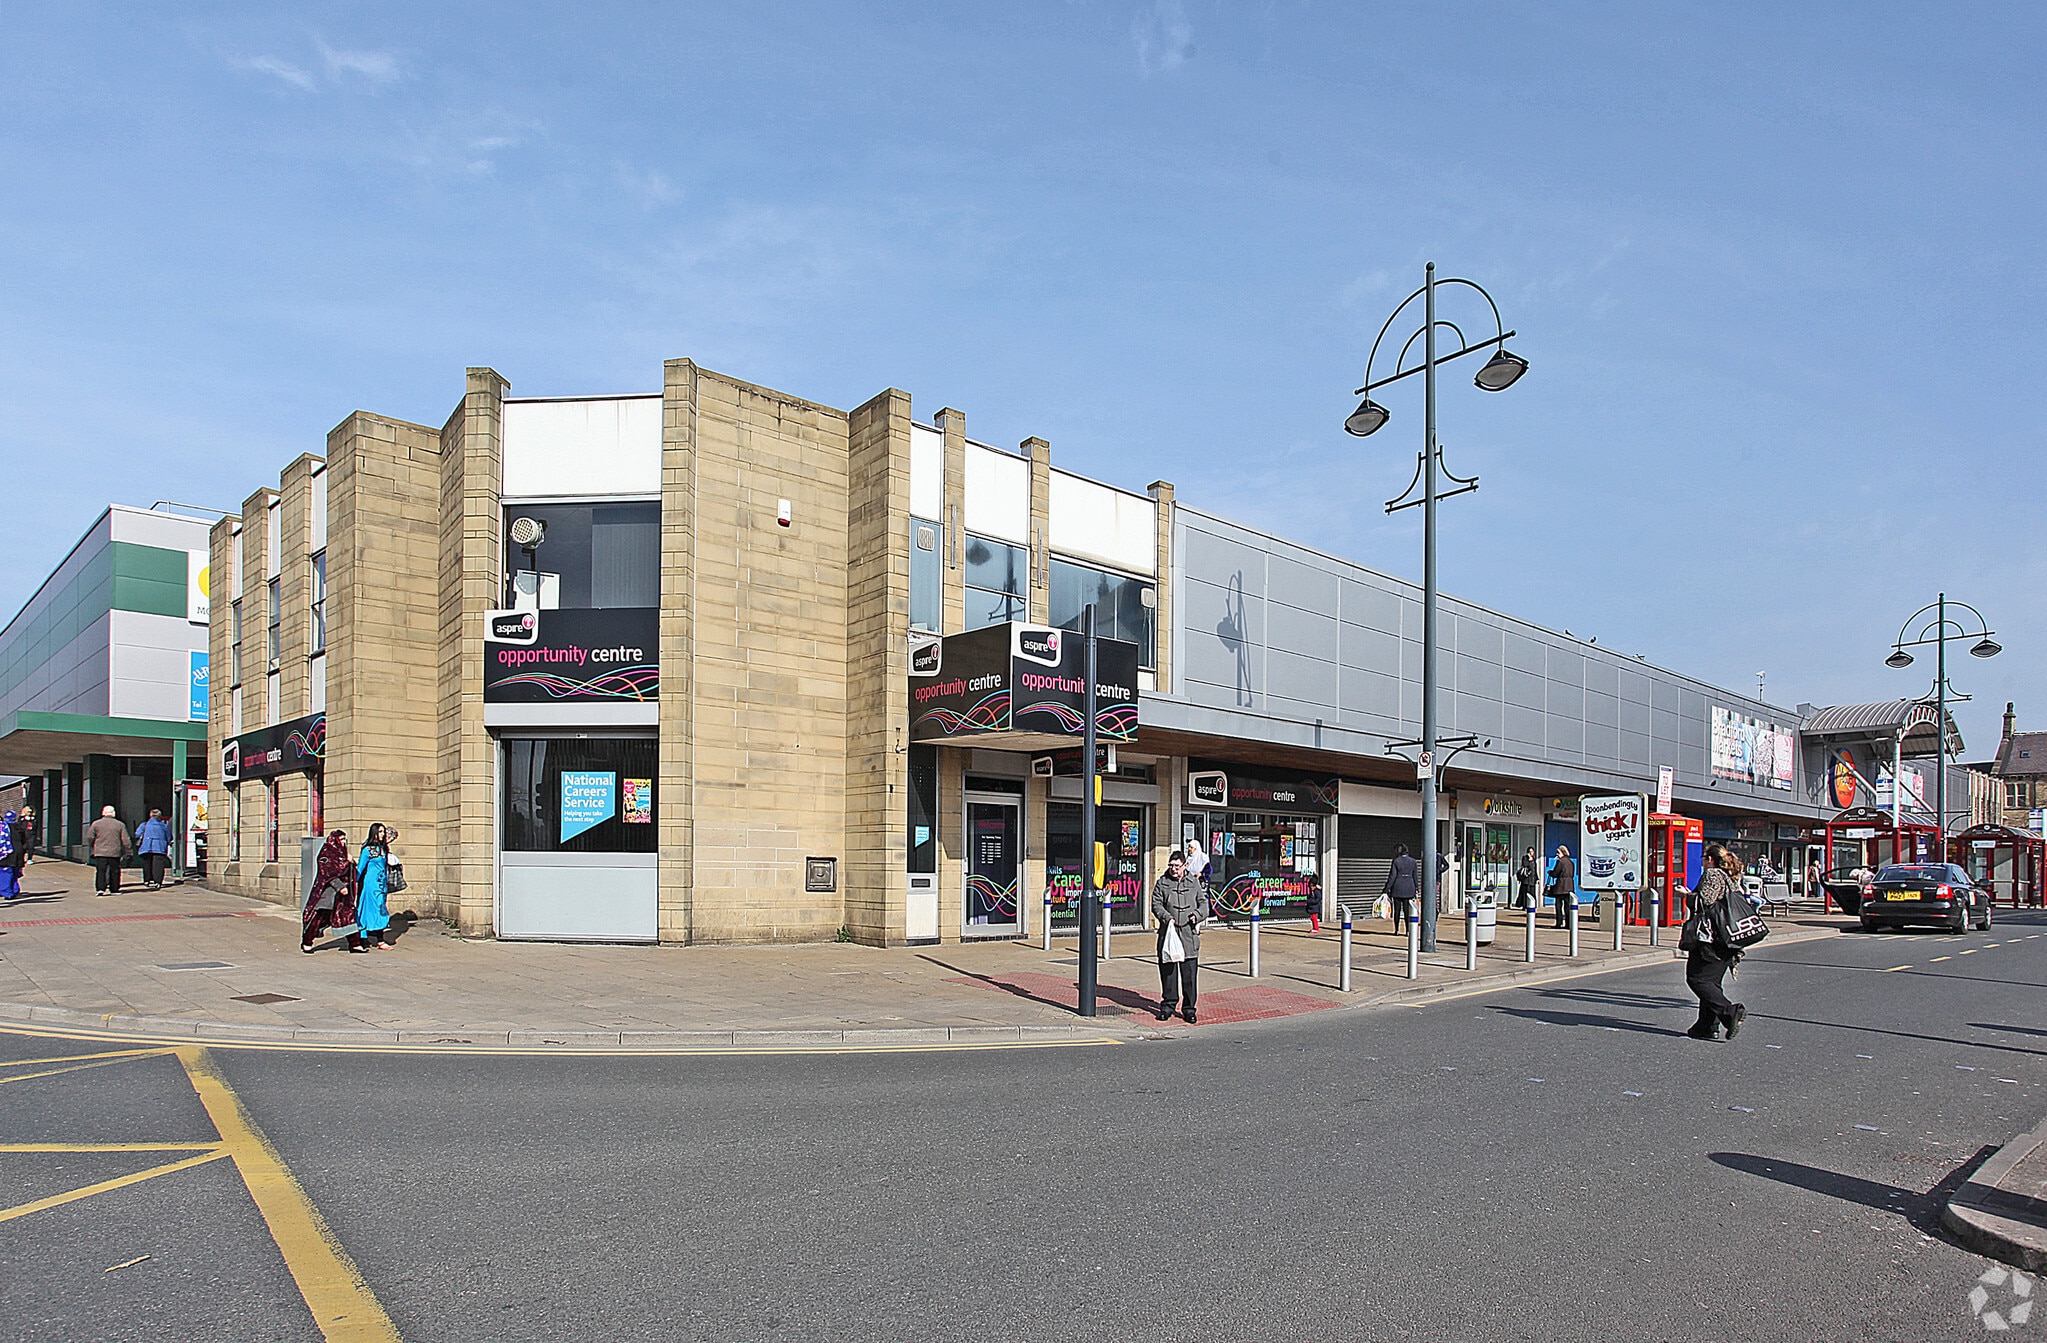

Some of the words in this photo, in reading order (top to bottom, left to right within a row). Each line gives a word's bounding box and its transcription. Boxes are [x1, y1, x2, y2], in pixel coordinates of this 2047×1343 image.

[496, 623, 523, 635] aspire
[1023, 639, 1049, 653] aspire
[498, 645, 589, 667] opportunity
[591, 645, 643, 662] centre
[915, 656, 932, 671] aspire
[915, 677, 967, 703] opportunity
[968, 673, 1002, 693] centre
[1022, 672, 1085, 694] opportunit
[1095, 682, 1131, 701] centre
[1713, 716, 1745, 743] Bradford
[1713, 736, 1743, 759] Markets
[564, 774, 613, 786] National
[564, 785, 607, 797] Careers
[1197, 784, 1217, 797] aspire
[1231, 787, 1273, 803] opportunity
[1273, 790, 1296, 802] centre
[564, 797, 605, 808] Service
[1118, 860, 1137, 875] jobs
[1054, 874, 1082, 887] care
[1255, 878, 1285, 888] career
[1726, 916, 1763, 936] USC
